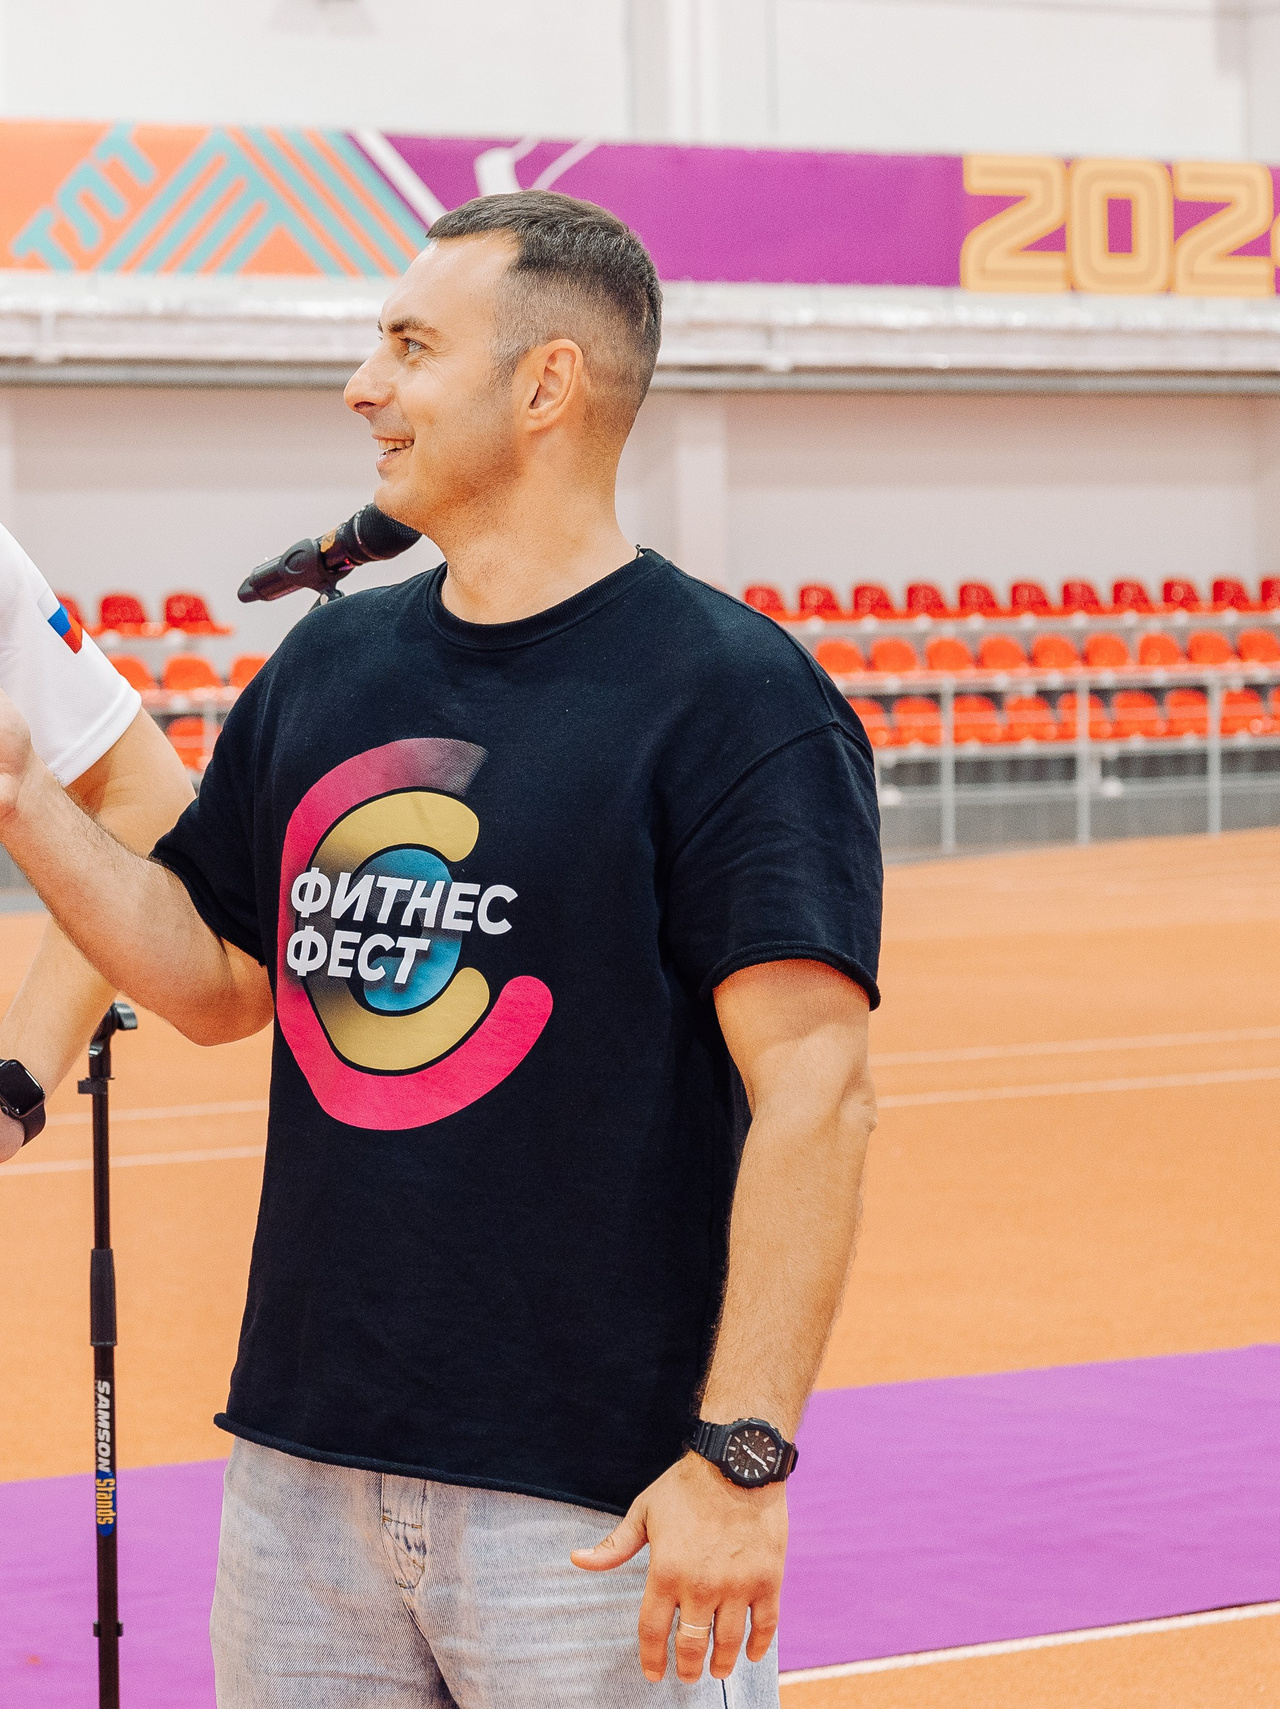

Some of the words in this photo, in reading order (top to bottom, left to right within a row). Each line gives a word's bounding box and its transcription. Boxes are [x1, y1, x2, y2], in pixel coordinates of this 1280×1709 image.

[960, 153, 1280, 297] 202
[290, 866, 518, 935] ФИТНЕС
[286, 925, 431, 985] ФЕСТ
[96, 1379, 111, 1473] SAMSON
[94, 1477, 117, 1525] Stands
